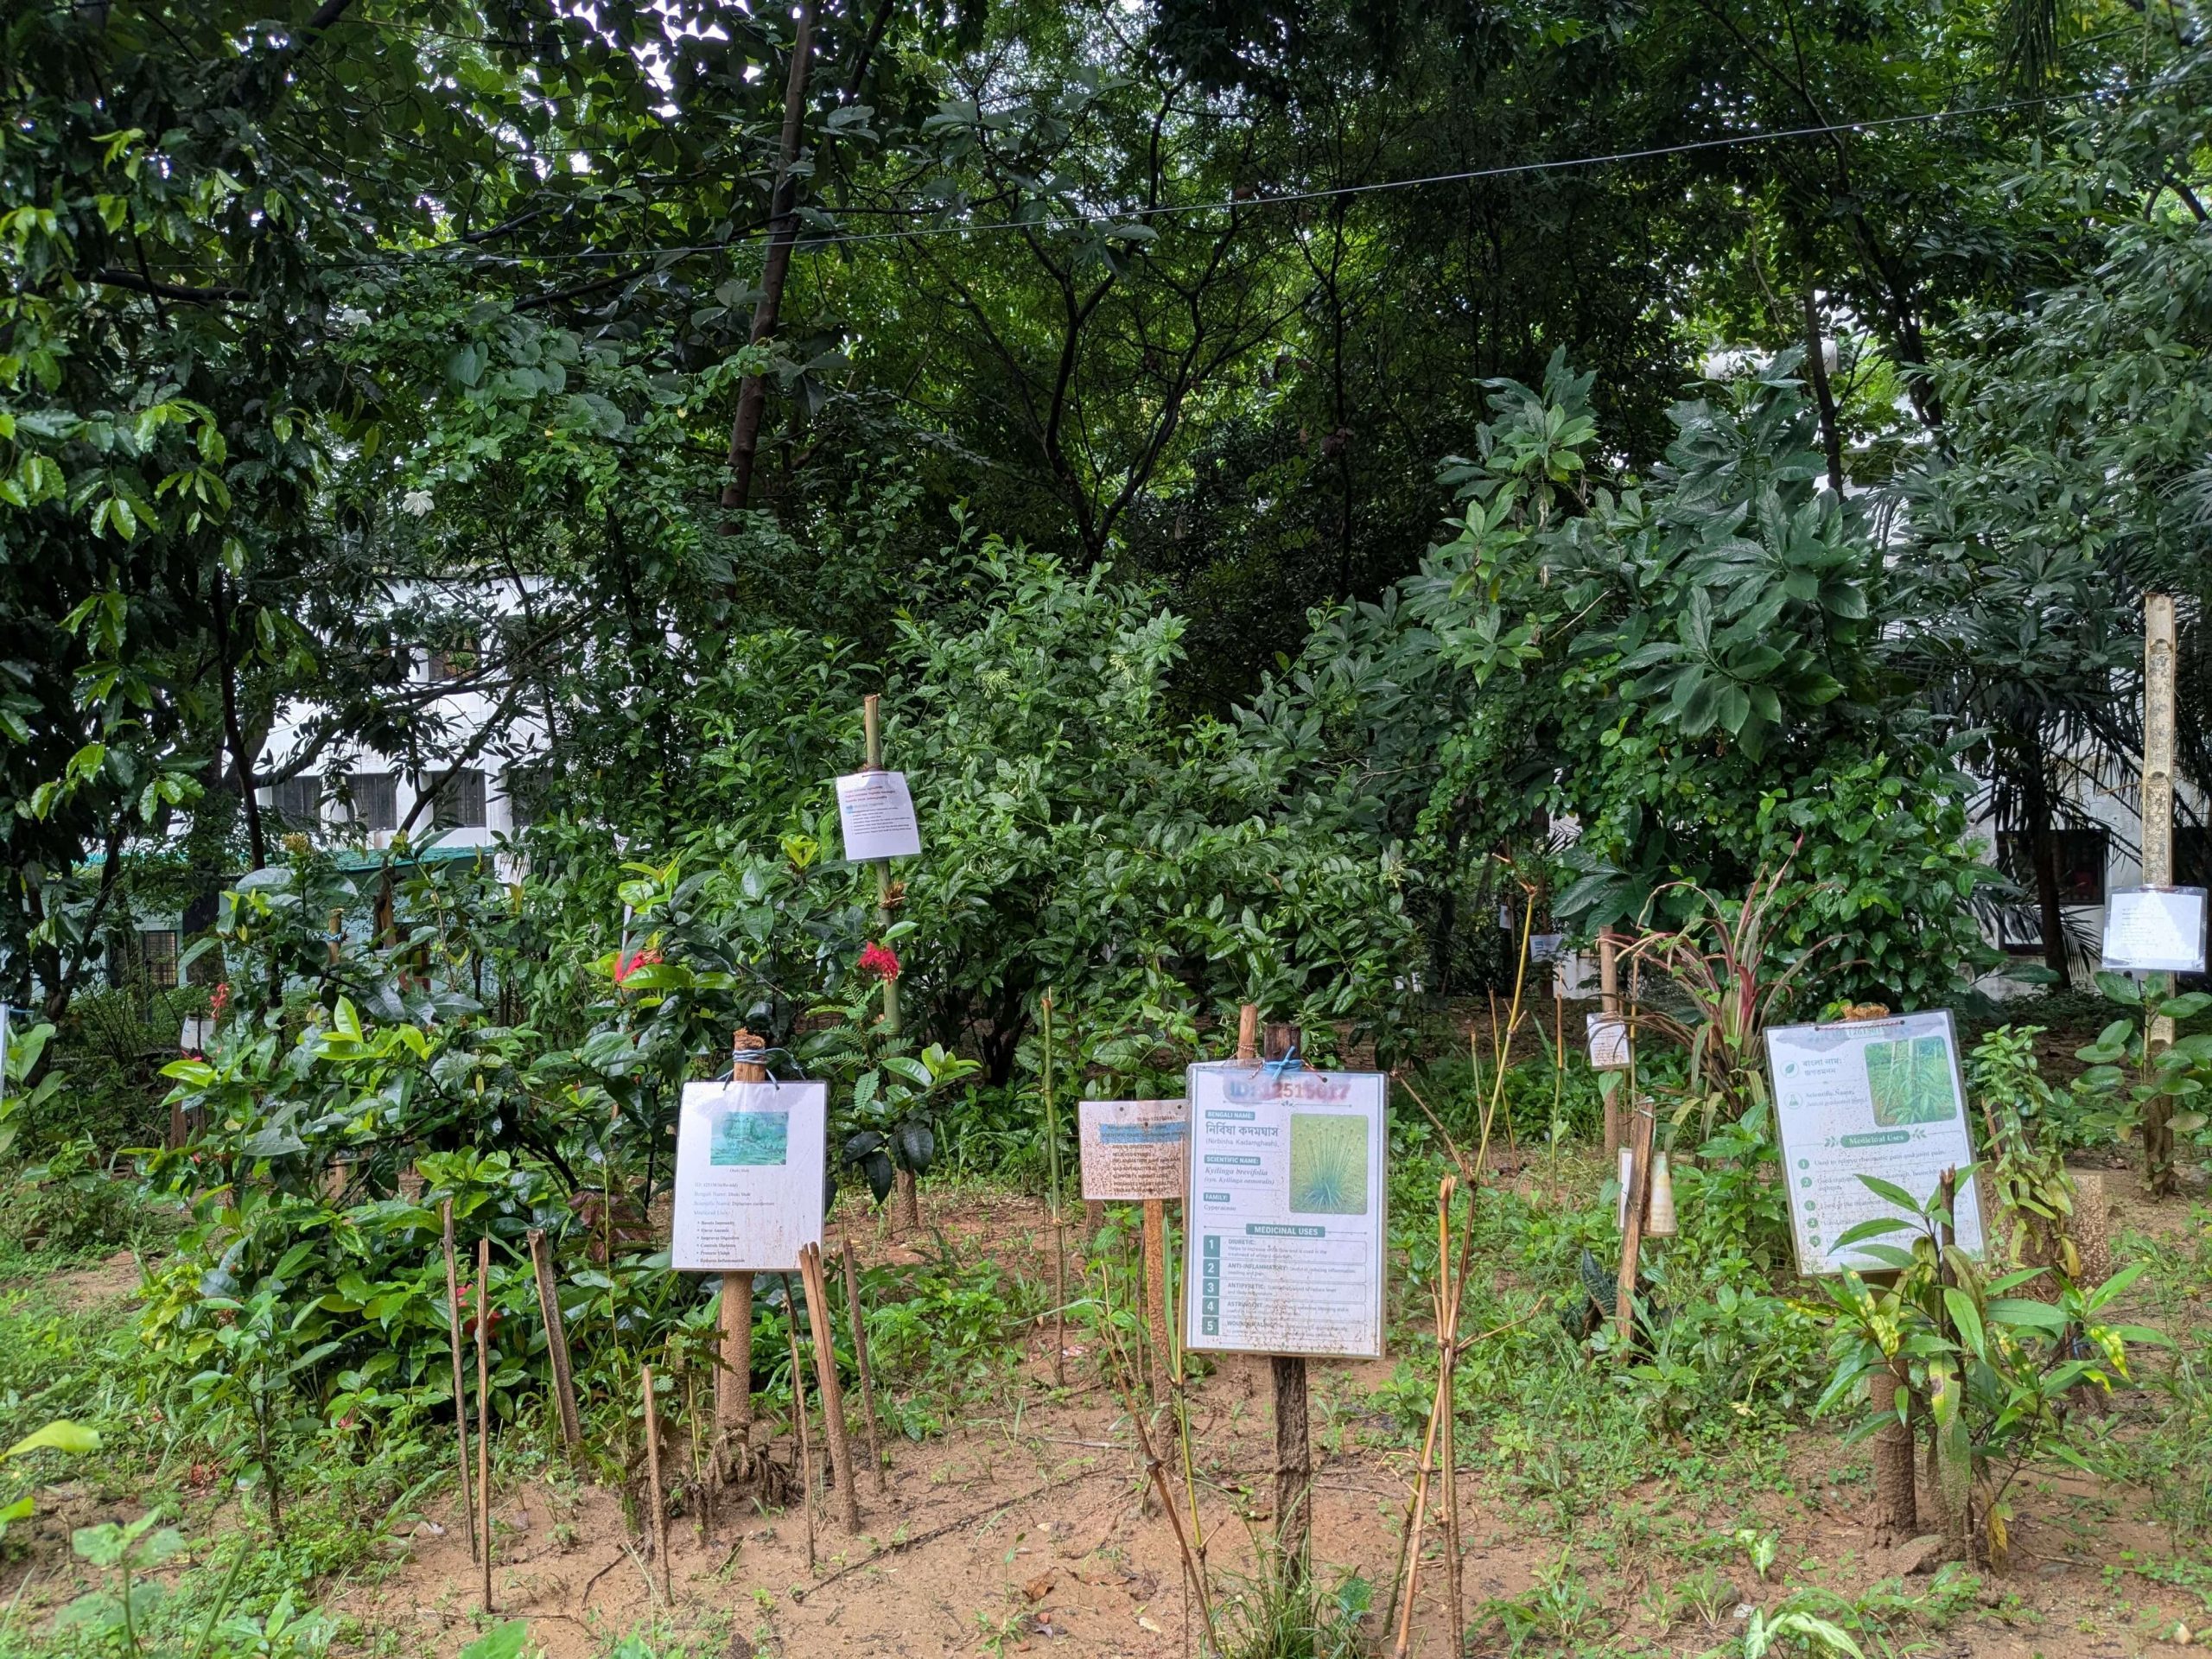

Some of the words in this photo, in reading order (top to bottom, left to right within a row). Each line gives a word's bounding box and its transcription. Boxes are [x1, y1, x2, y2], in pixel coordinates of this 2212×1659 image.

[1205, 1122, 1236, 1135] নির্বিষা
[1237, 1126, 1280, 1137] কদমঘাস
[1848, 1135, 1885, 1145] Medicinal
[1236, 1168, 1268, 1177] brevifolia
[1254, 1225, 1297, 1236] MEDICINAL
[1208, 1239, 1214, 1249] 1
[1207, 1262, 1215, 1274] 2
[1207, 1282, 1214, 1293] 3
[1206, 1301, 1214, 1312] 4
[1206, 1320, 1214, 1332] 5
